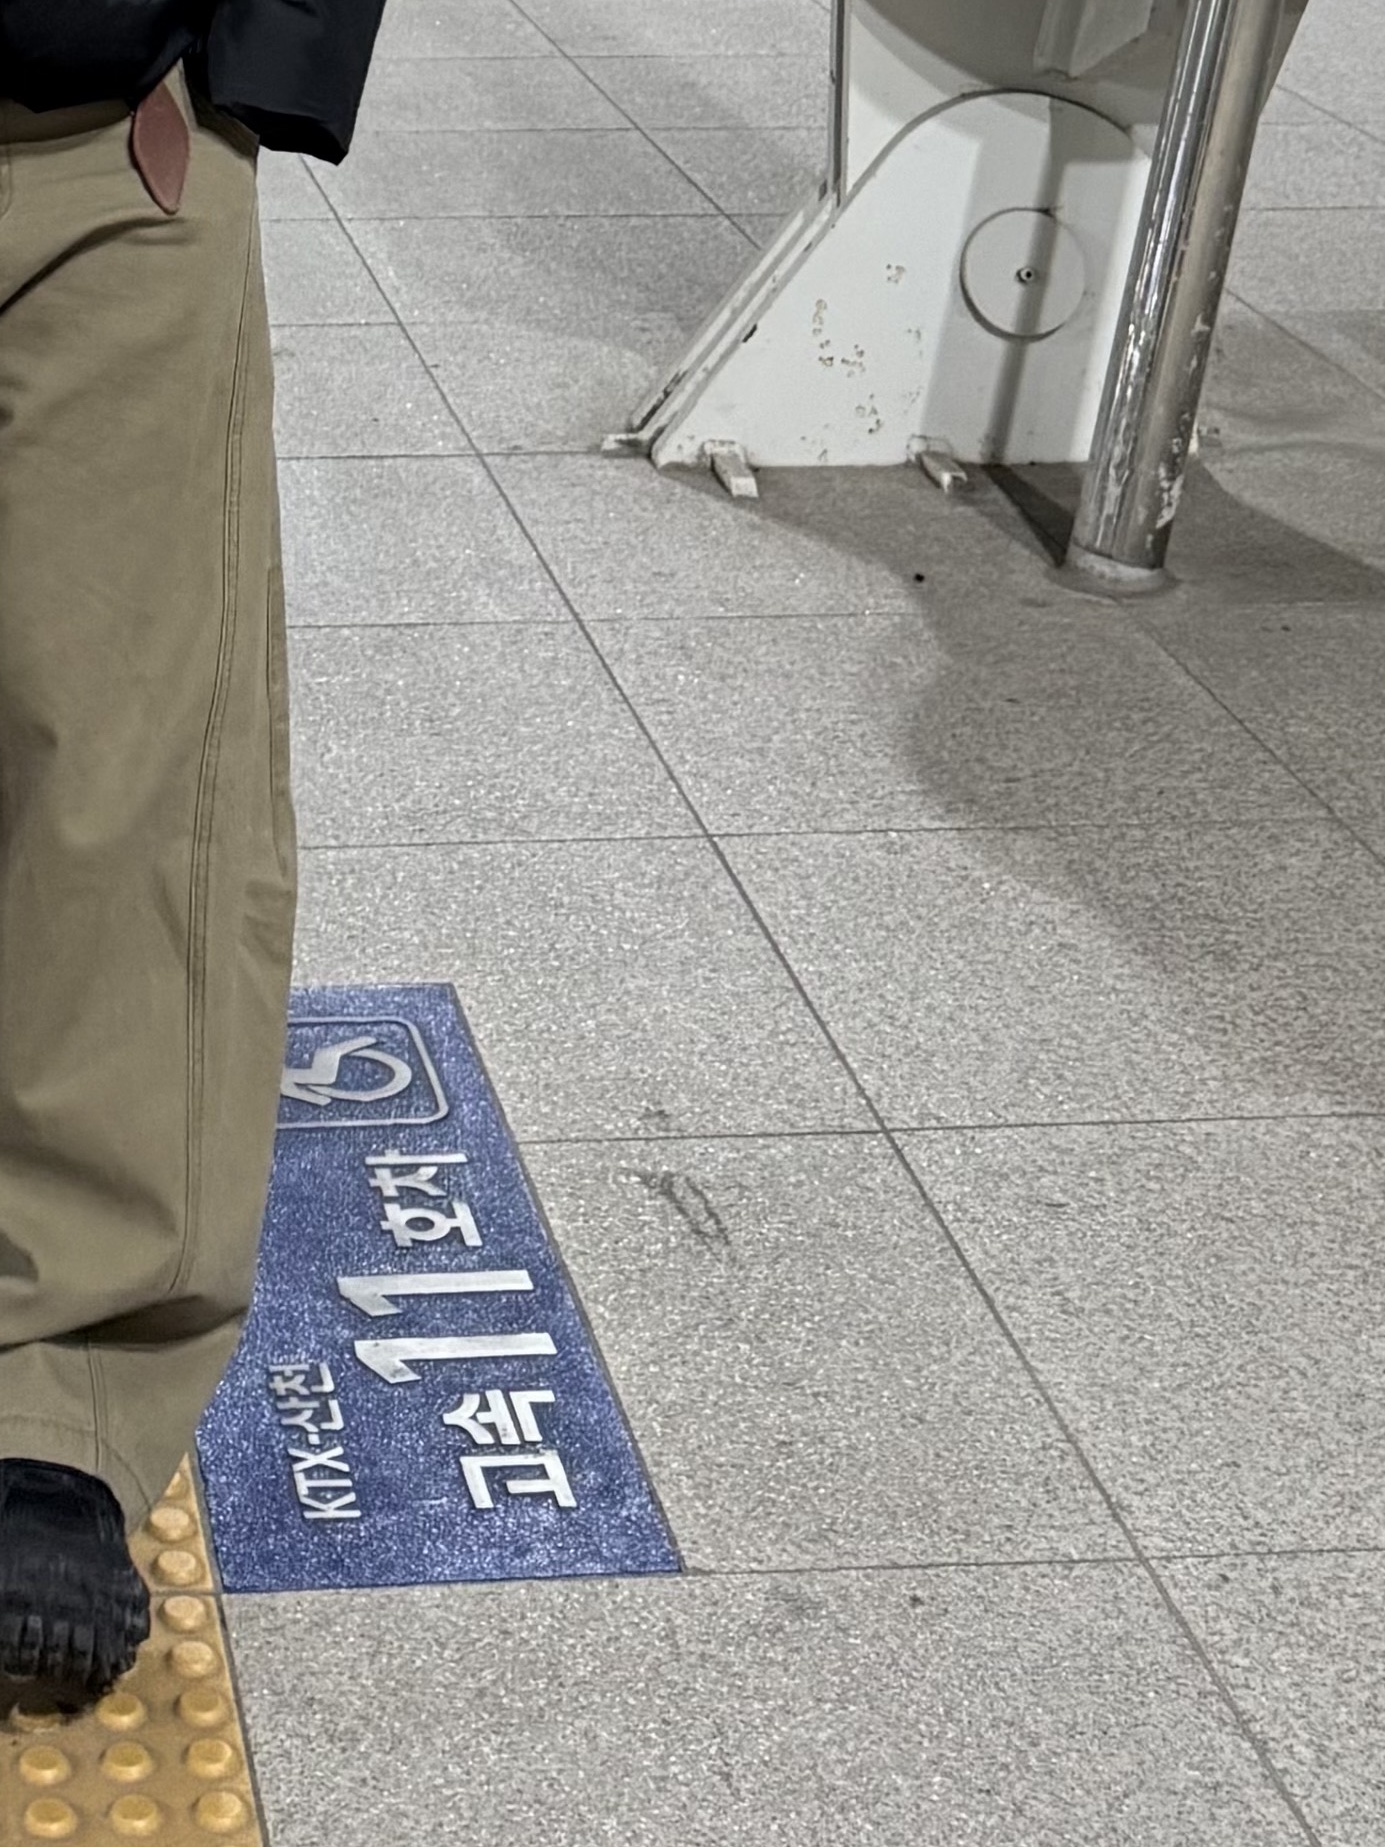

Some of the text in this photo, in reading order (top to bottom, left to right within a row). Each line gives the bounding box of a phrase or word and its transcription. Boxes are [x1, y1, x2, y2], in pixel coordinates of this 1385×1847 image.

[336, 1150, 577, 1509] 고속 11 호차
